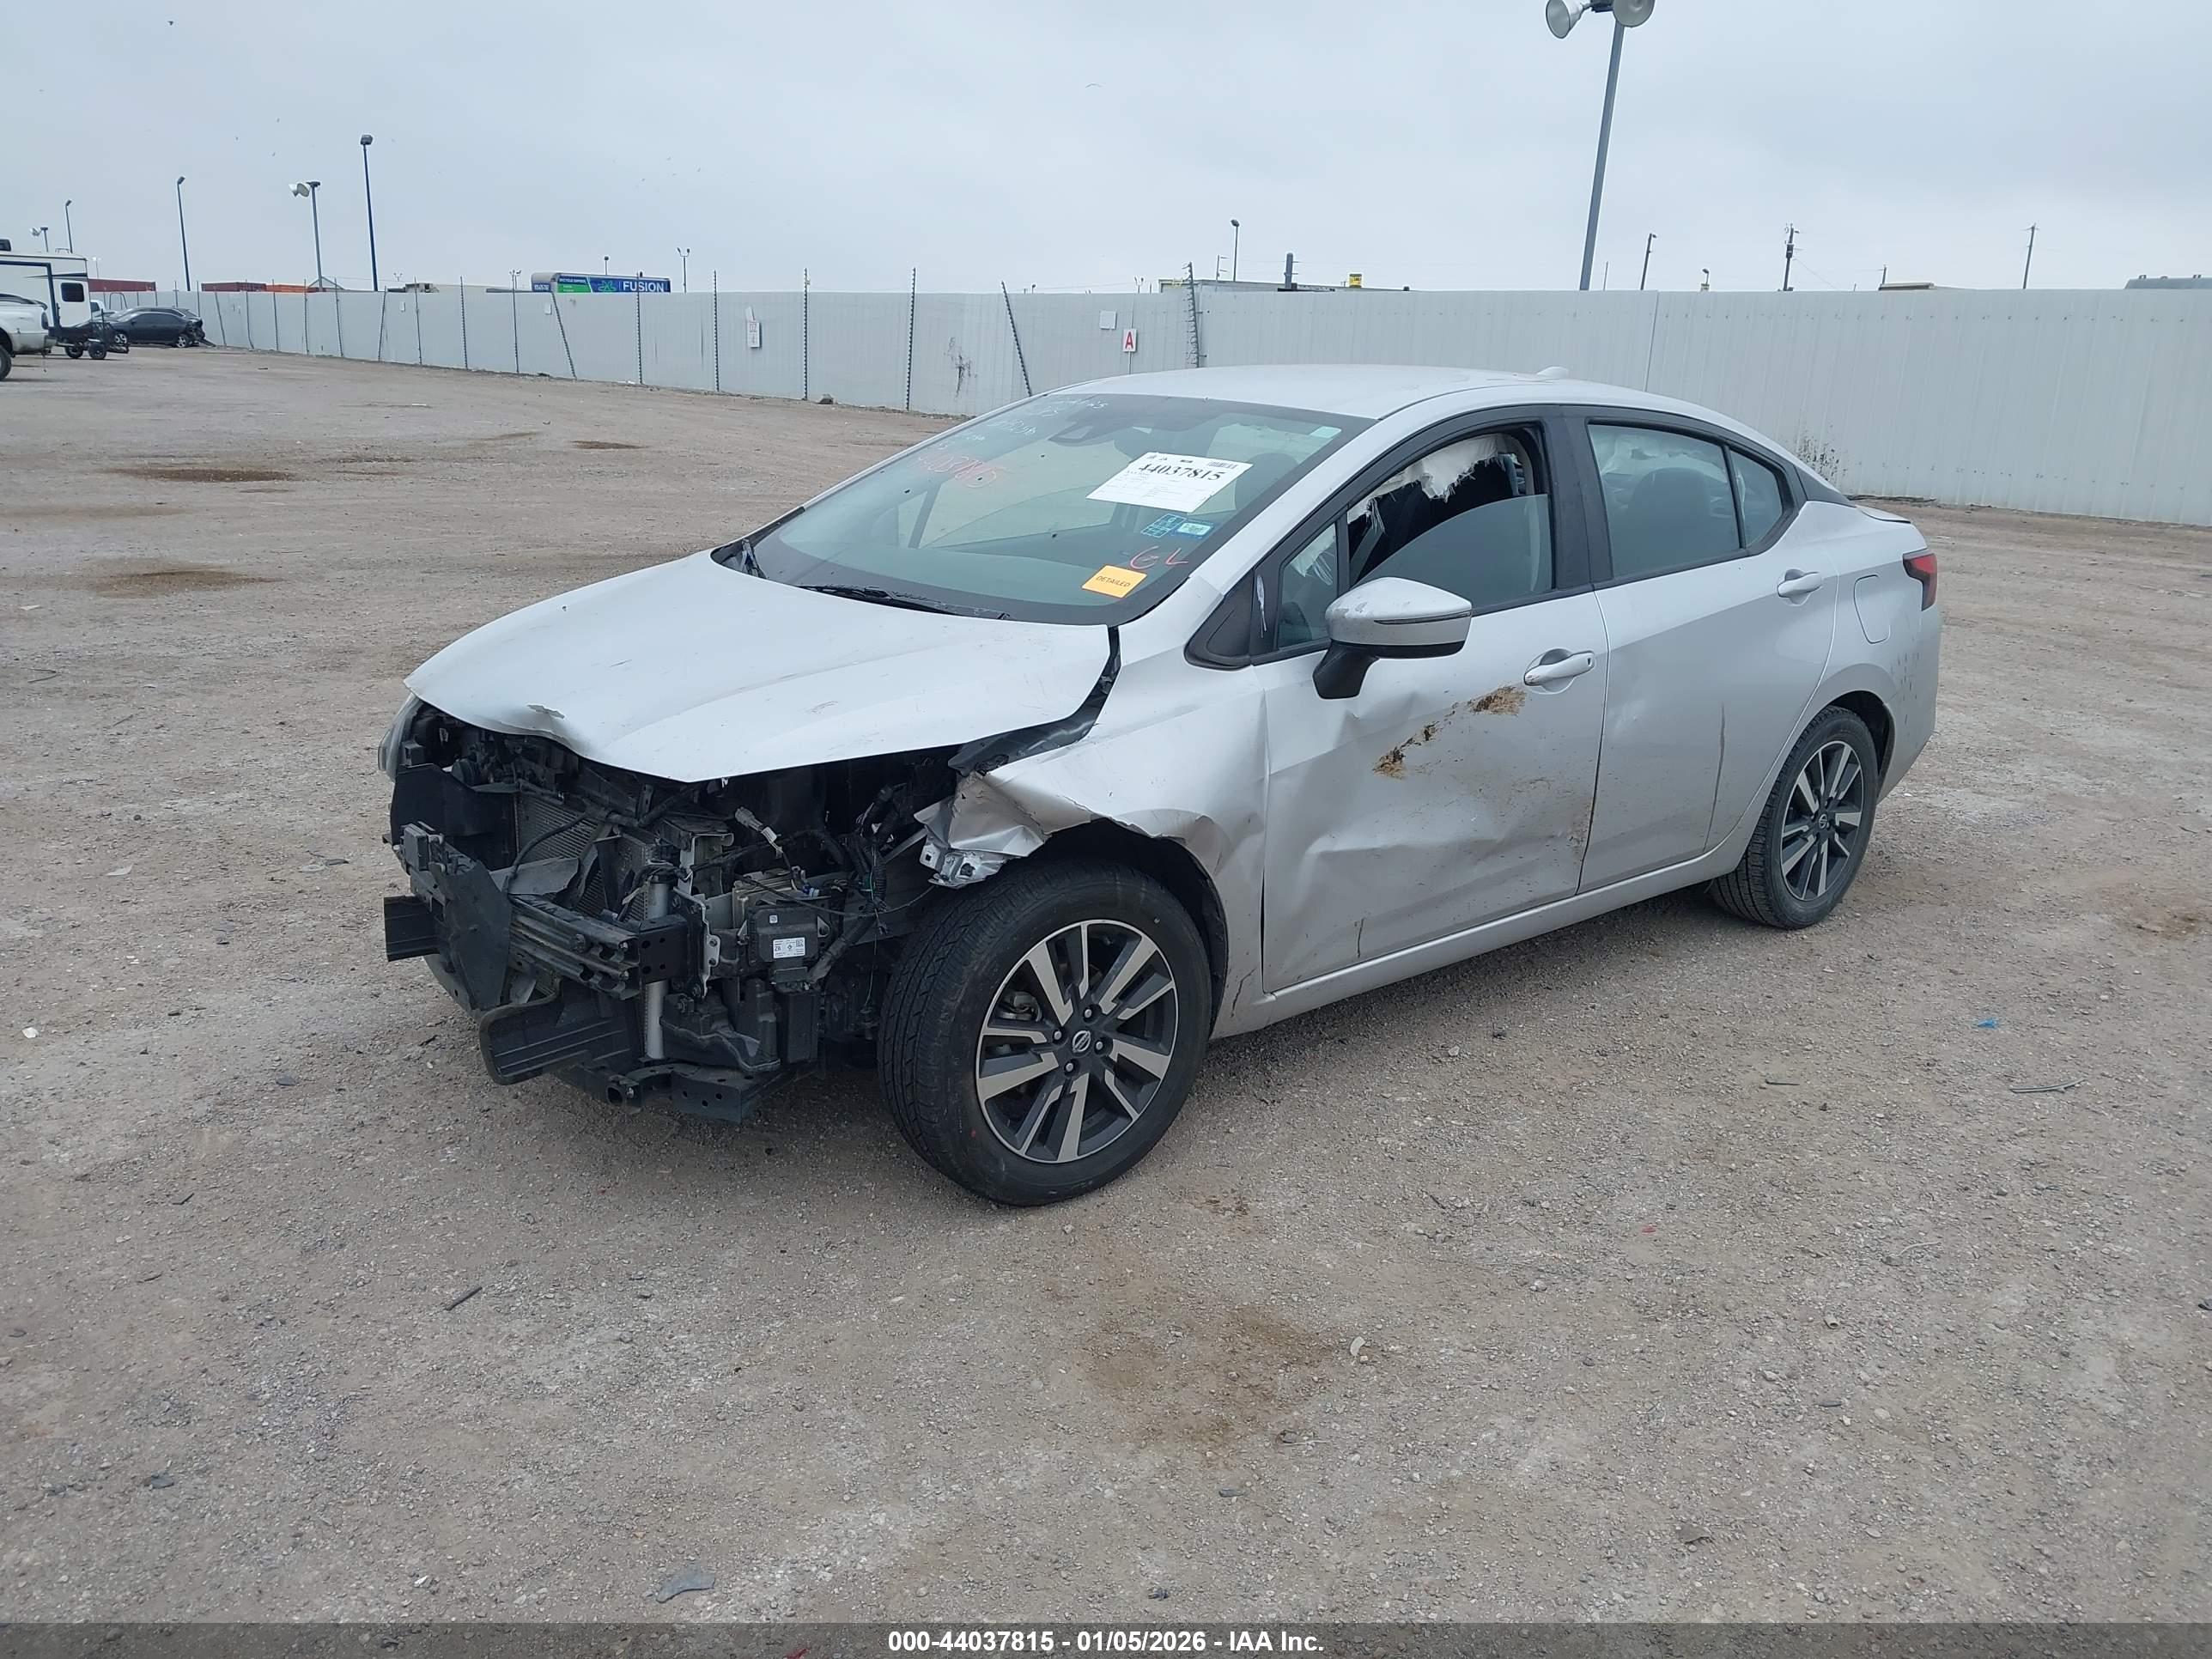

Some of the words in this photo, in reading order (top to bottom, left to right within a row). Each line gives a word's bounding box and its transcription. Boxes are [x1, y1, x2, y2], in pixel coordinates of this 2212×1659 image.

[623, 281, 665, 293] FUSION
[1125, 331, 1133, 349] A
[1137, 463, 1226, 481] 44037815
[1096, 574, 1131, 588] DETAILED
